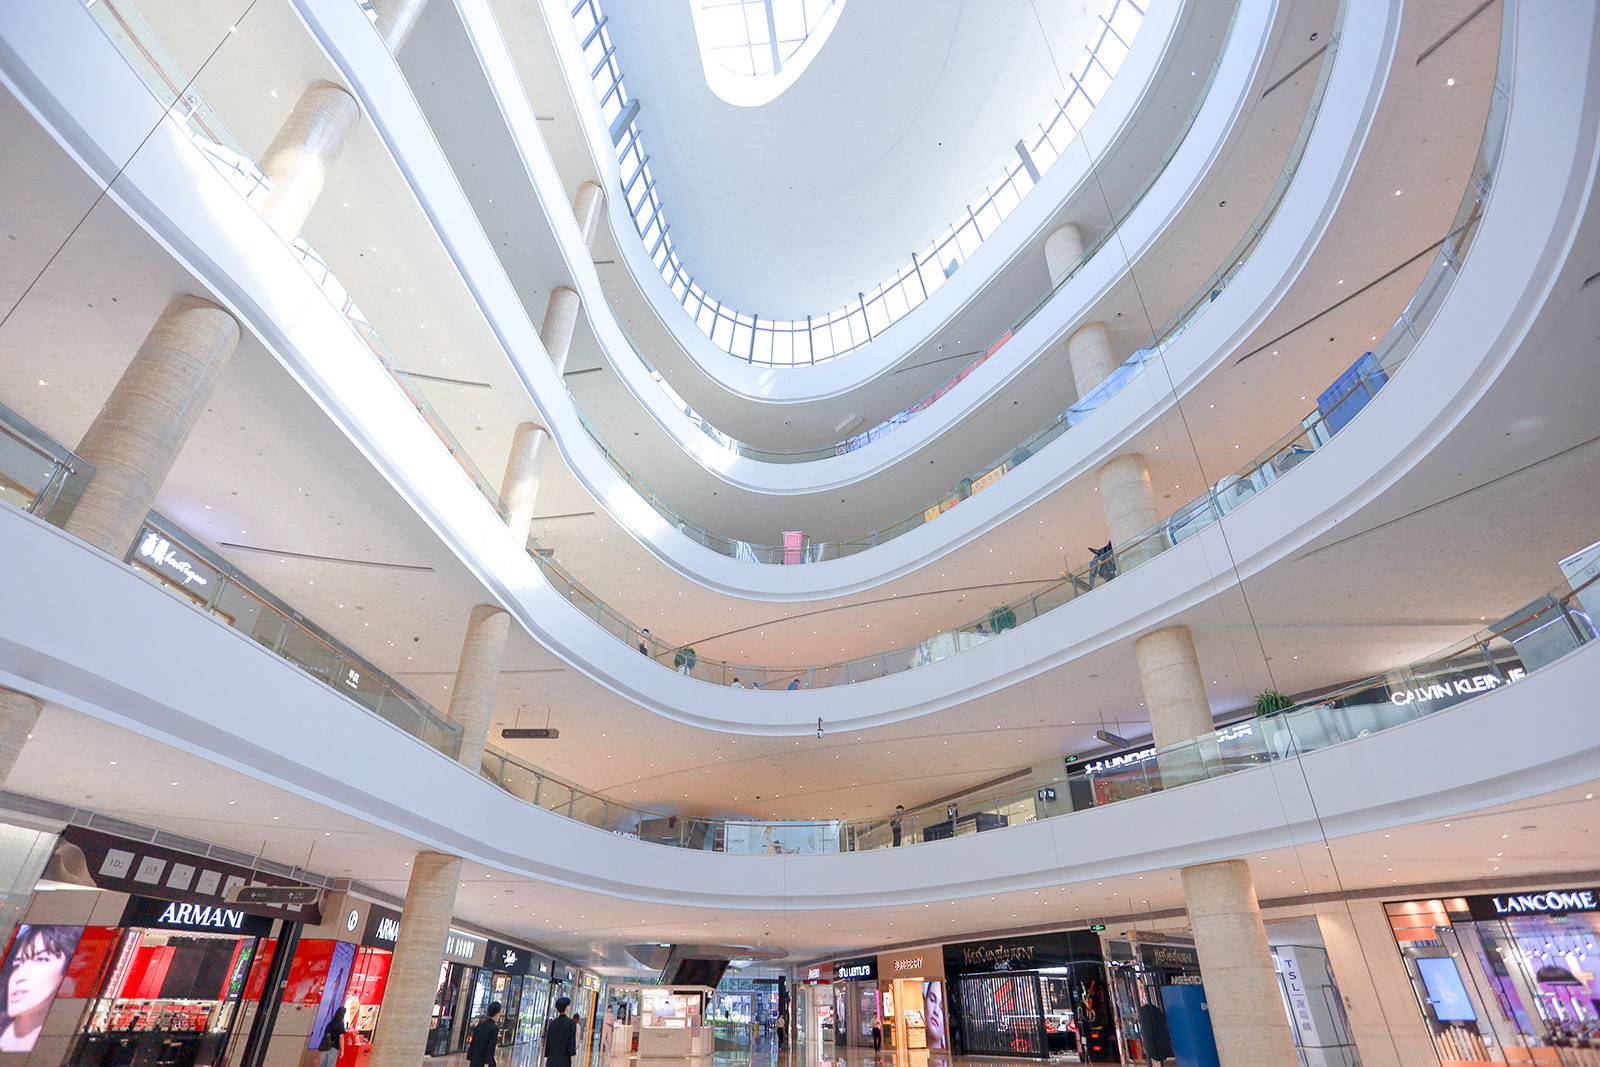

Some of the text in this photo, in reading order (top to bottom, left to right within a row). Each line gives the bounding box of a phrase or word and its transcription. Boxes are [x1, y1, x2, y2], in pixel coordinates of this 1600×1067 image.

[1391, 682, 1453, 706] CALVIN
[1453, 673, 1500, 695] KLEIN
[158, 901, 245, 929] ARMANI
[1492, 891, 1597, 914] LANCÔME
[1284, 959, 1300, 992] TSL
